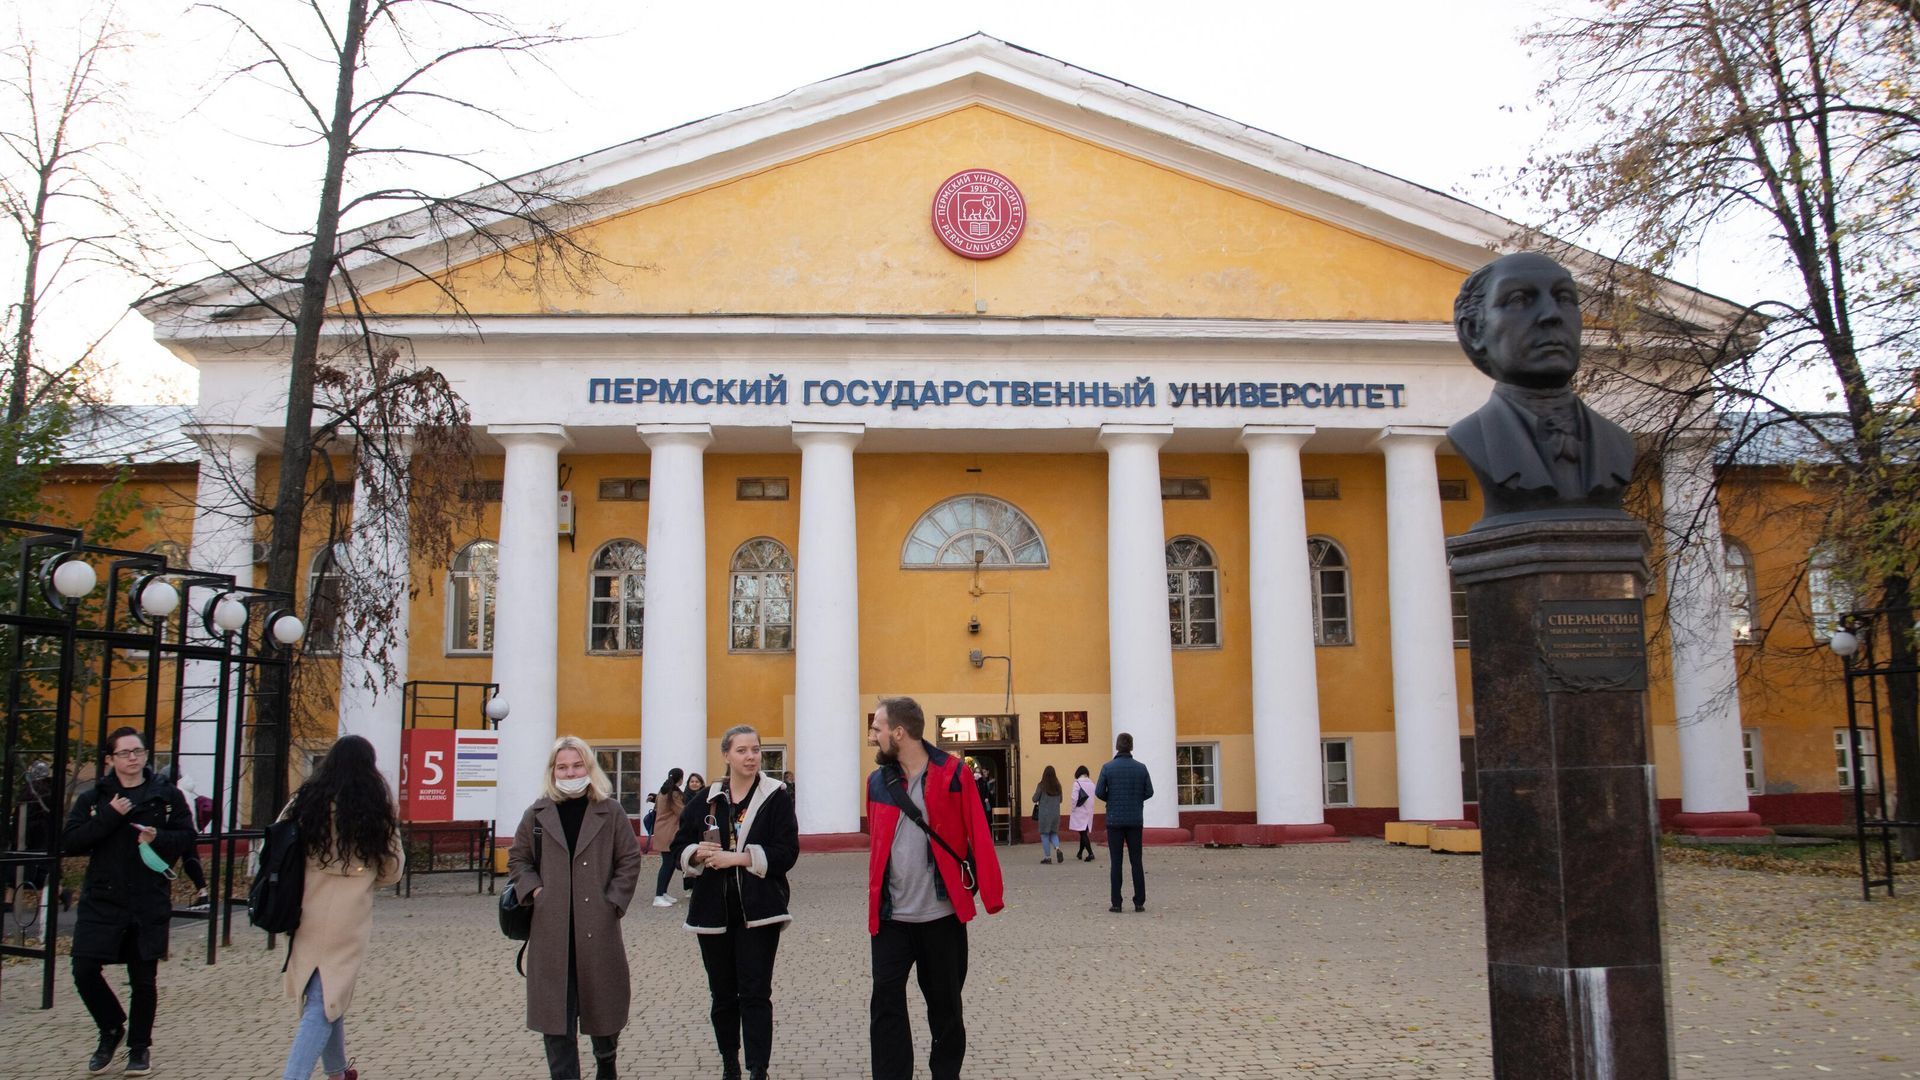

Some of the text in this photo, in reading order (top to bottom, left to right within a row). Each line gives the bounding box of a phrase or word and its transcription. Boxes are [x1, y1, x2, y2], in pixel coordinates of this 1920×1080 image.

[938, 174, 1021, 217] ПЕРМСКИЙ УНИВЕРСИТЕТ
[970, 185, 988, 193] 1916
[942, 224, 1017, 251] PERM UNIVERSITY
[589, 373, 1405, 410] ПЕРМСКИЙ ГОСУДАРСТВЕННЫЙ УНИВЕРСИТЕТ
[422, 751, 444, 785] 5
